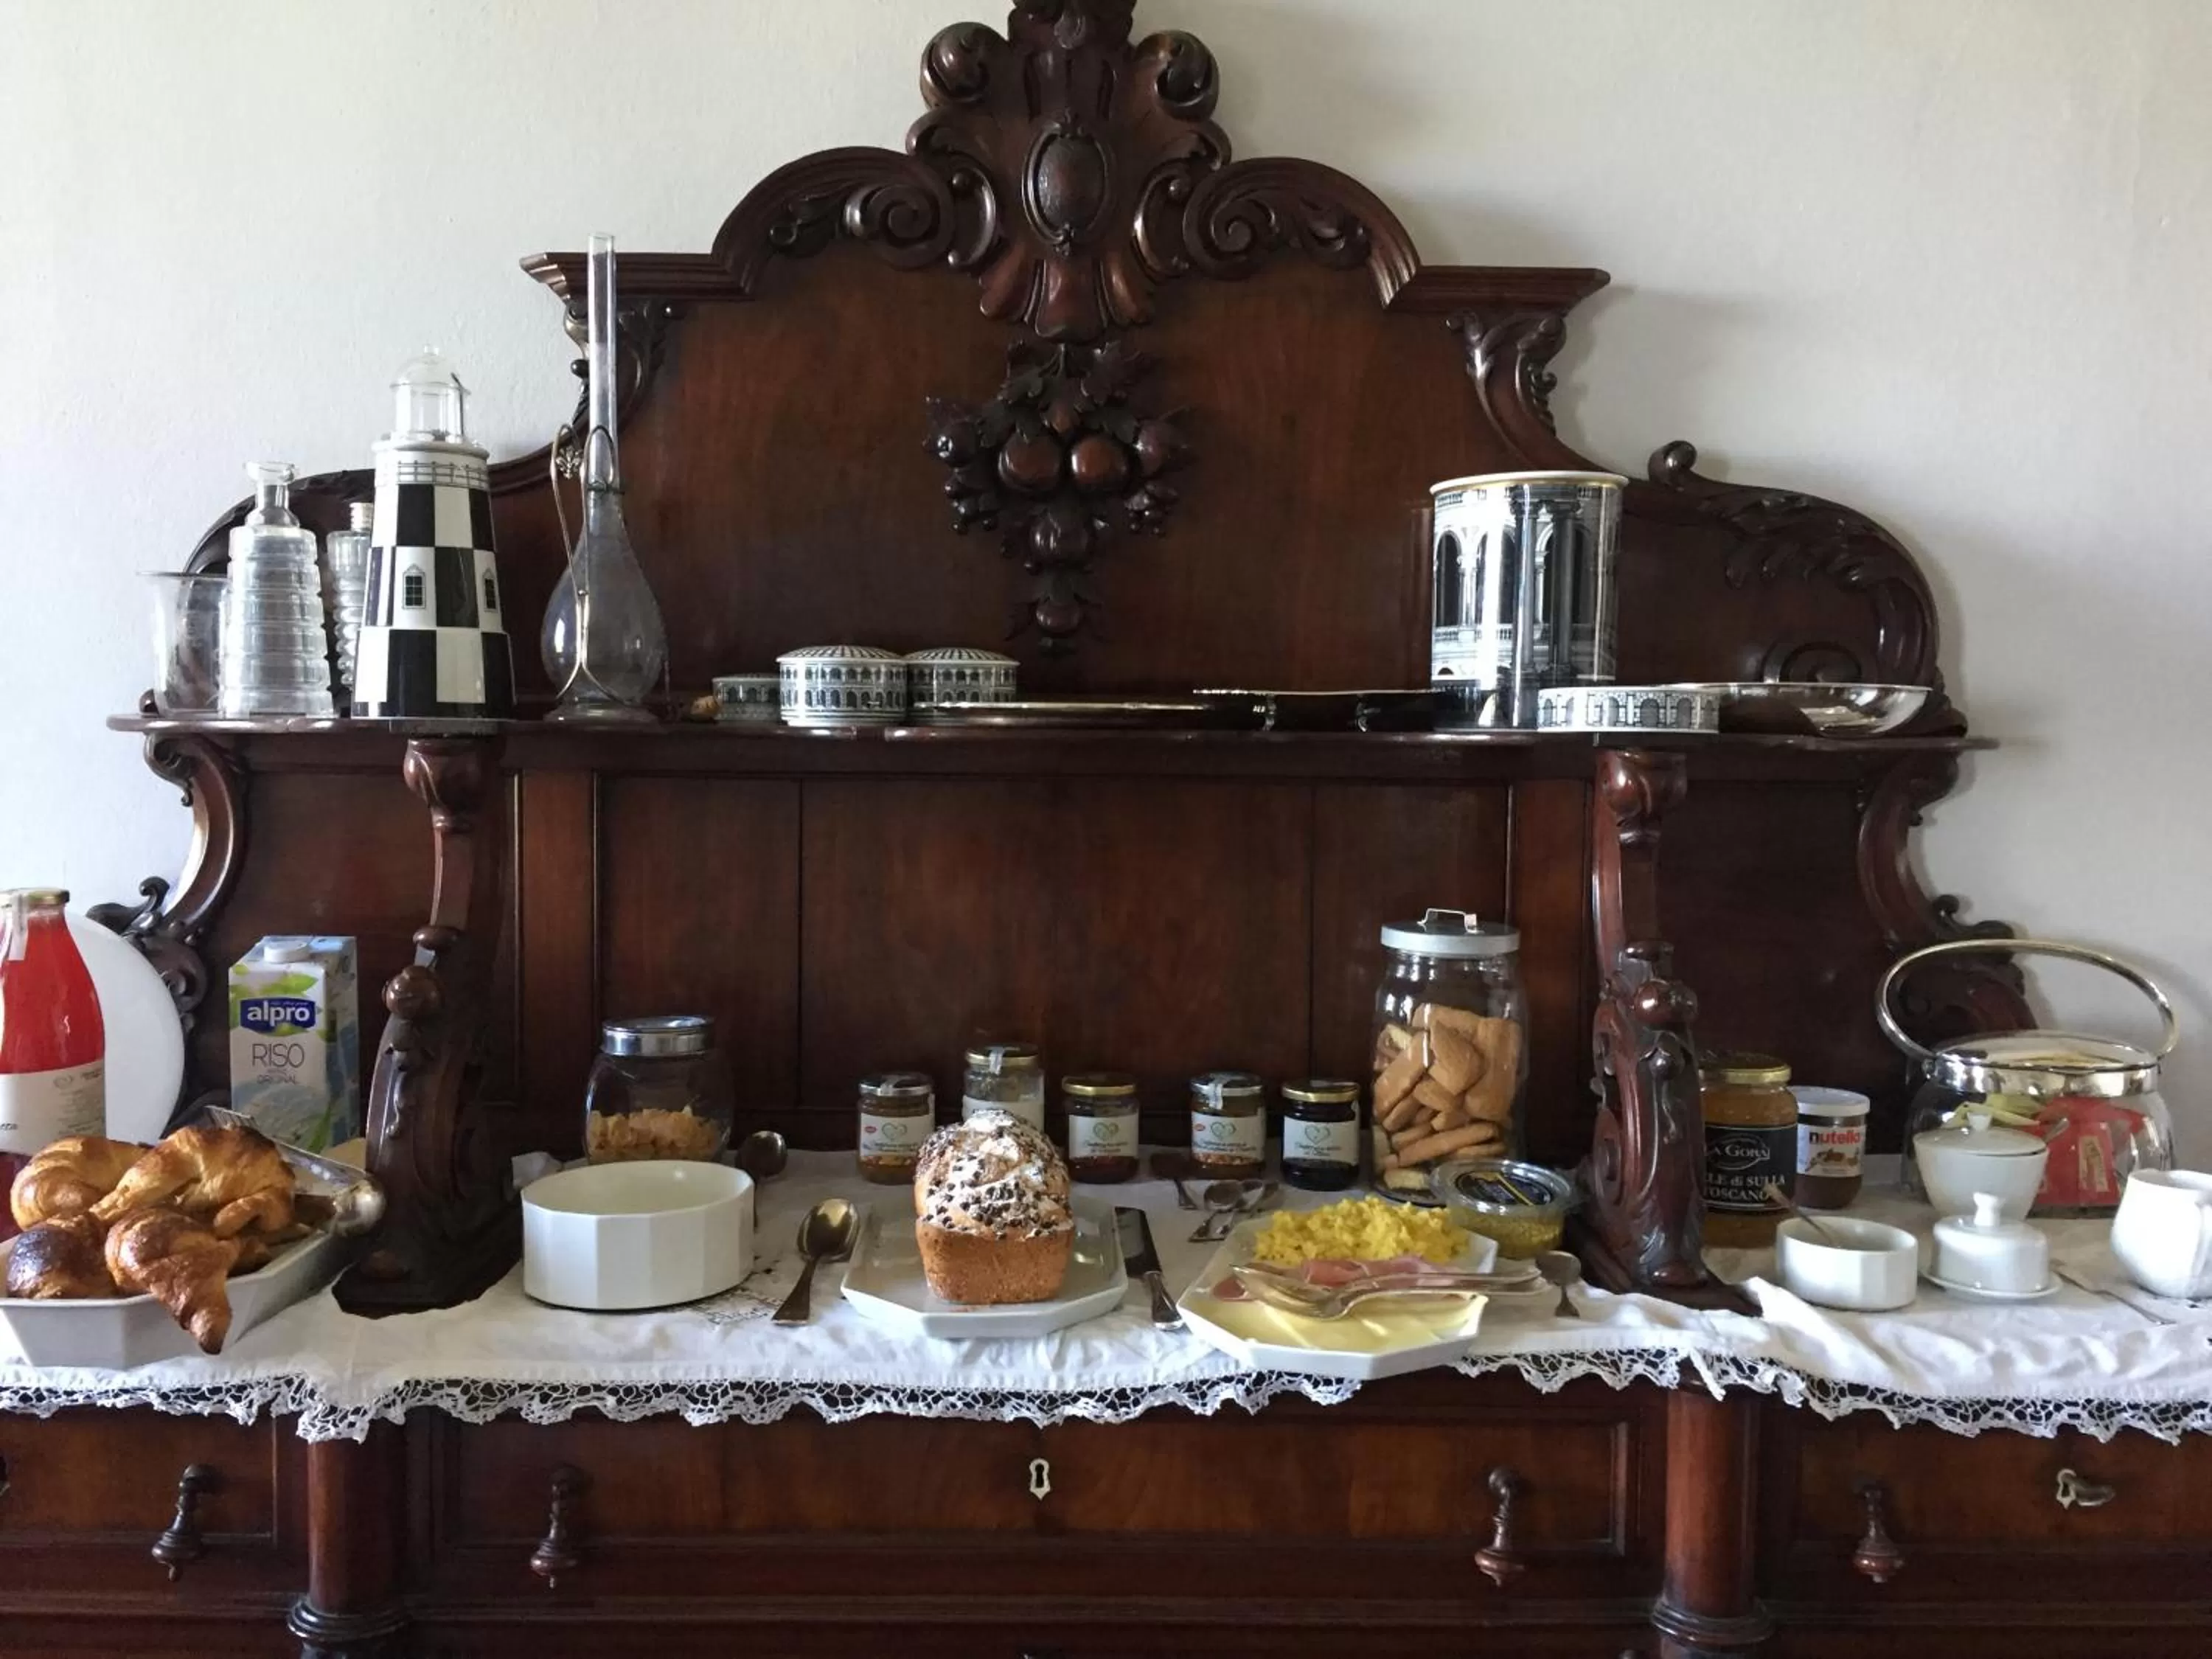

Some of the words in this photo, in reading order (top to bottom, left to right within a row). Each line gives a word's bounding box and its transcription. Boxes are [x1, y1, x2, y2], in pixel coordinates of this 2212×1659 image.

[247, 1001, 310, 1027] alpro
[251, 1043, 305, 1068] RISO
[1809, 1130, 1860, 1144] nutella
